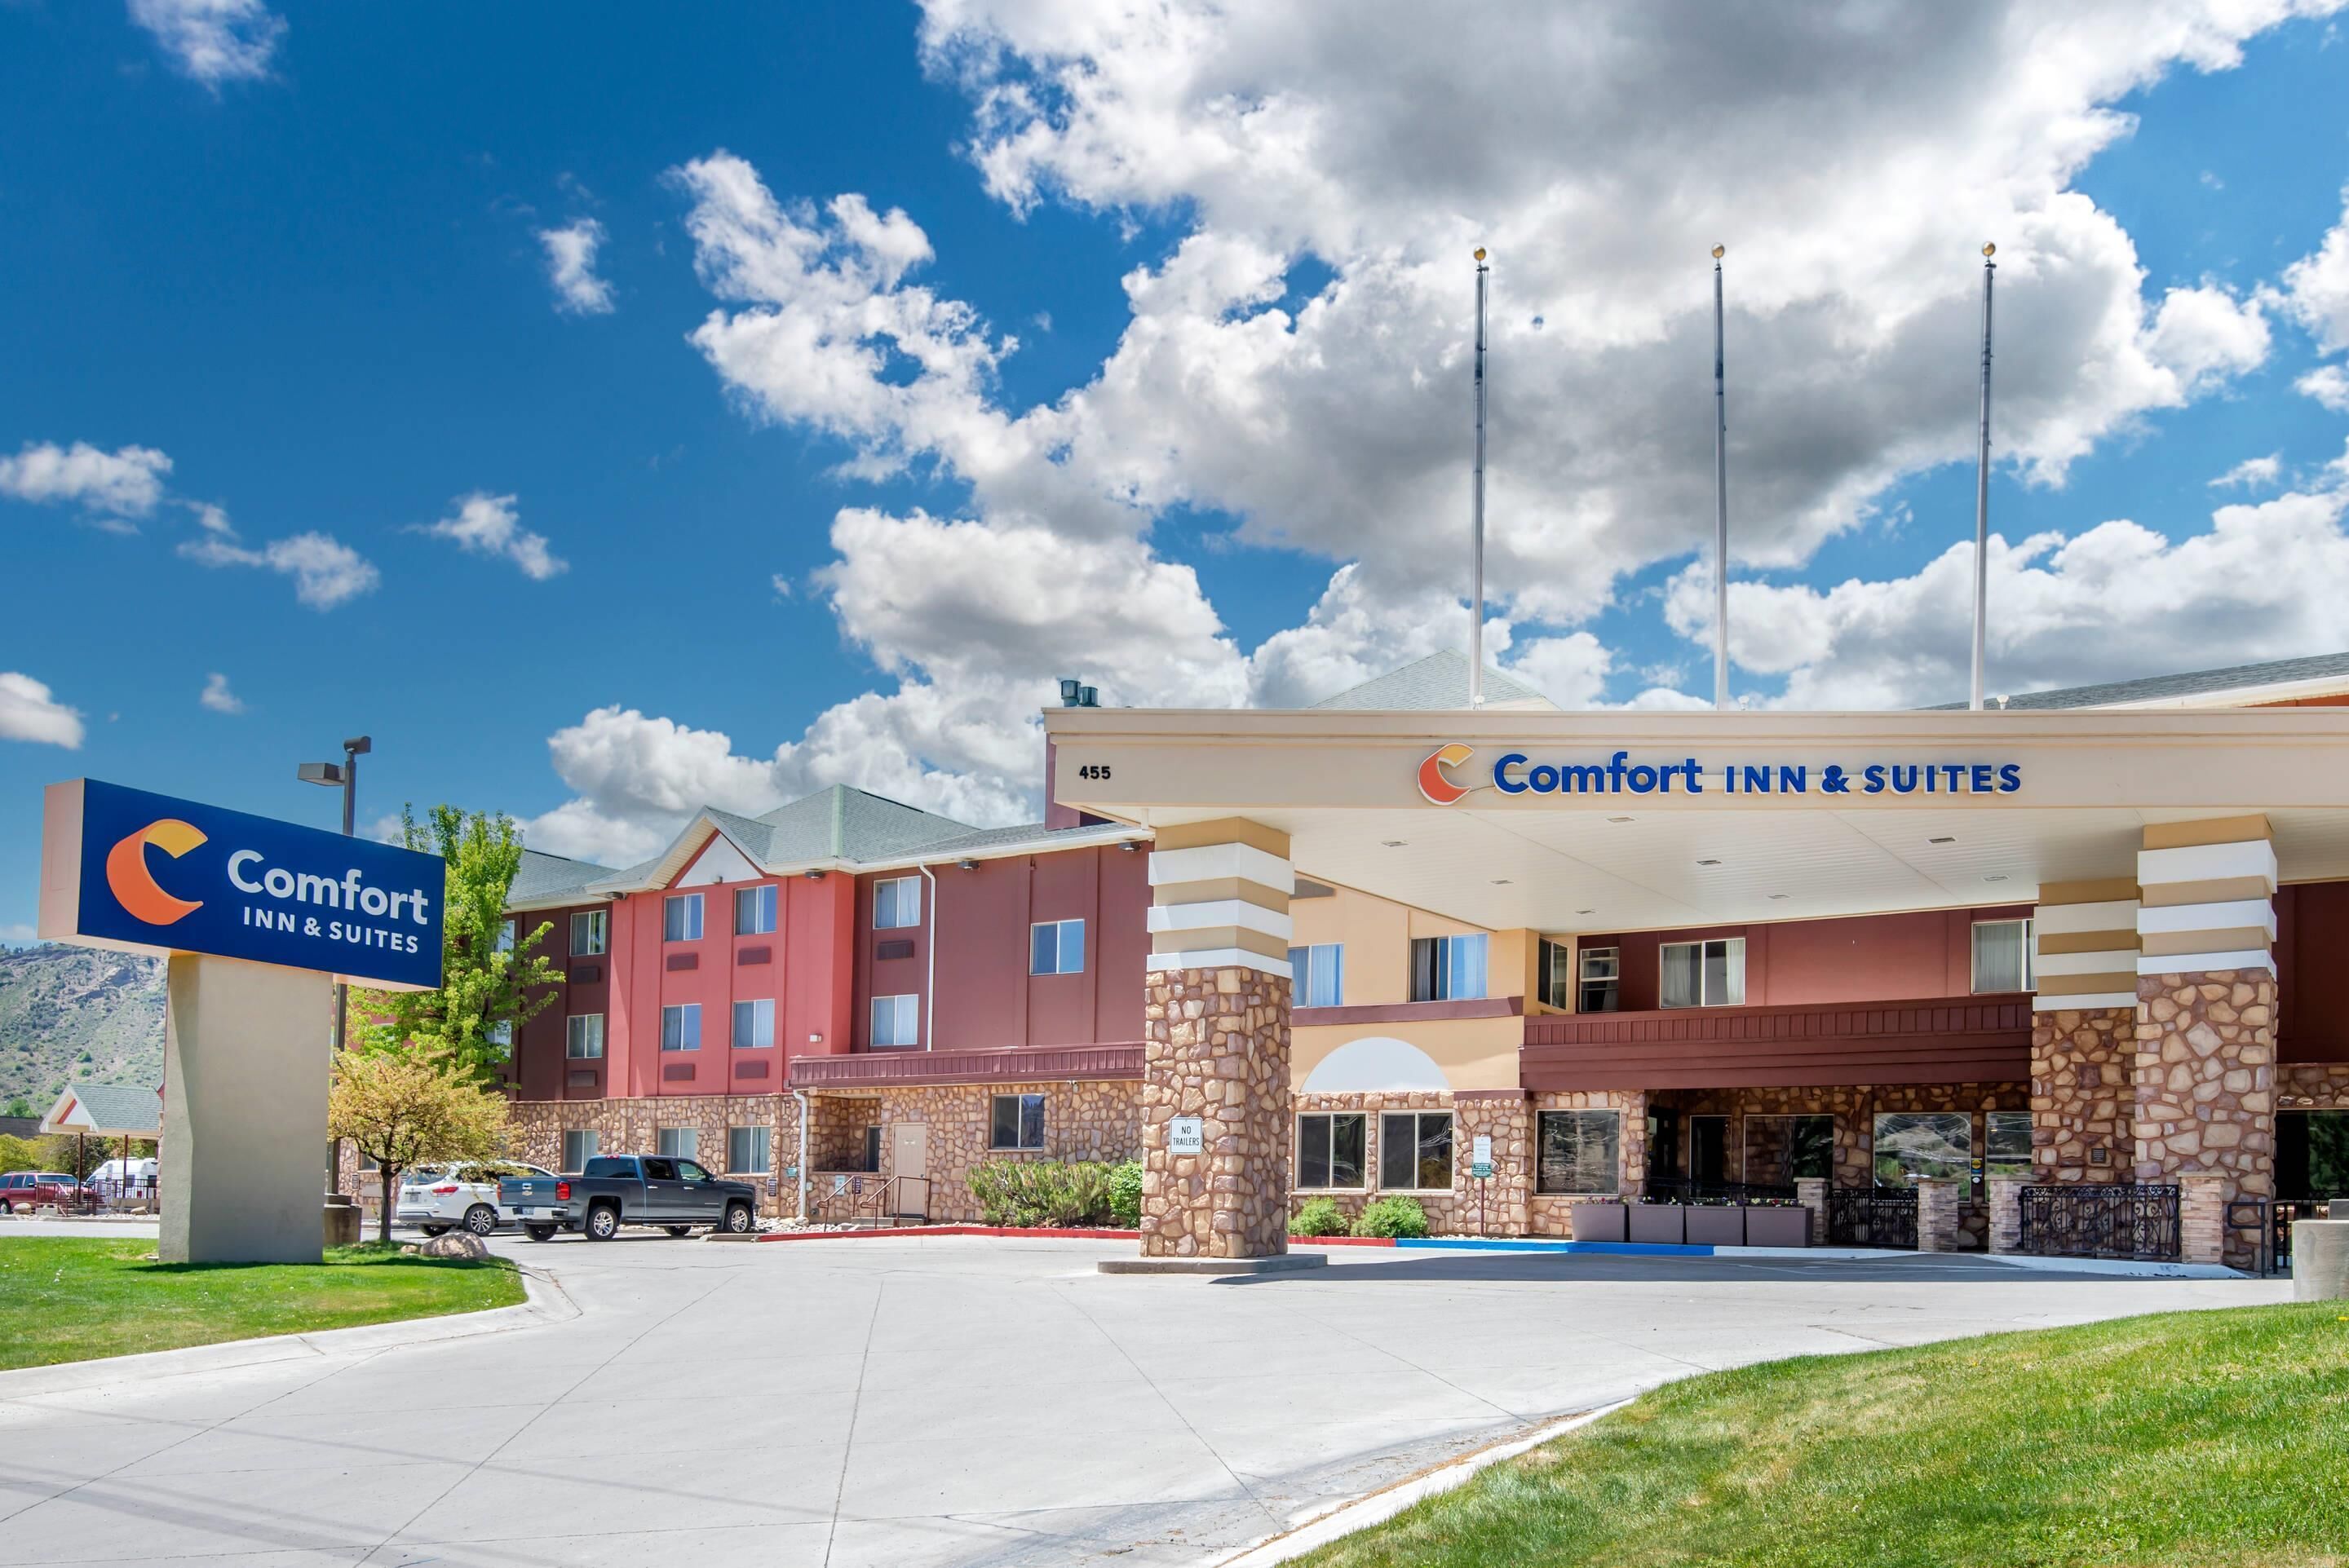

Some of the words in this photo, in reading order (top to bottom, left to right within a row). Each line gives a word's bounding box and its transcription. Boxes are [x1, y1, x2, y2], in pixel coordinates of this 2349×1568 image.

[1078, 765, 1112, 780] 455
[1493, 750, 1704, 795] Comfort
[1725, 765, 1807, 794] INN
[1820, 765, 1850, 793] &
[1863, 764, 2021, 793] SUITES
[228, 850, 428, 925] Comfort
[244, 906, 295, 933] INN
[303, 917, 322, 937] &
[329, 921, 418, 953] SUITES
[1173, 1137, 1200, 1146] TRAILERS
[1181, 1125, 1192, 1134] NO
